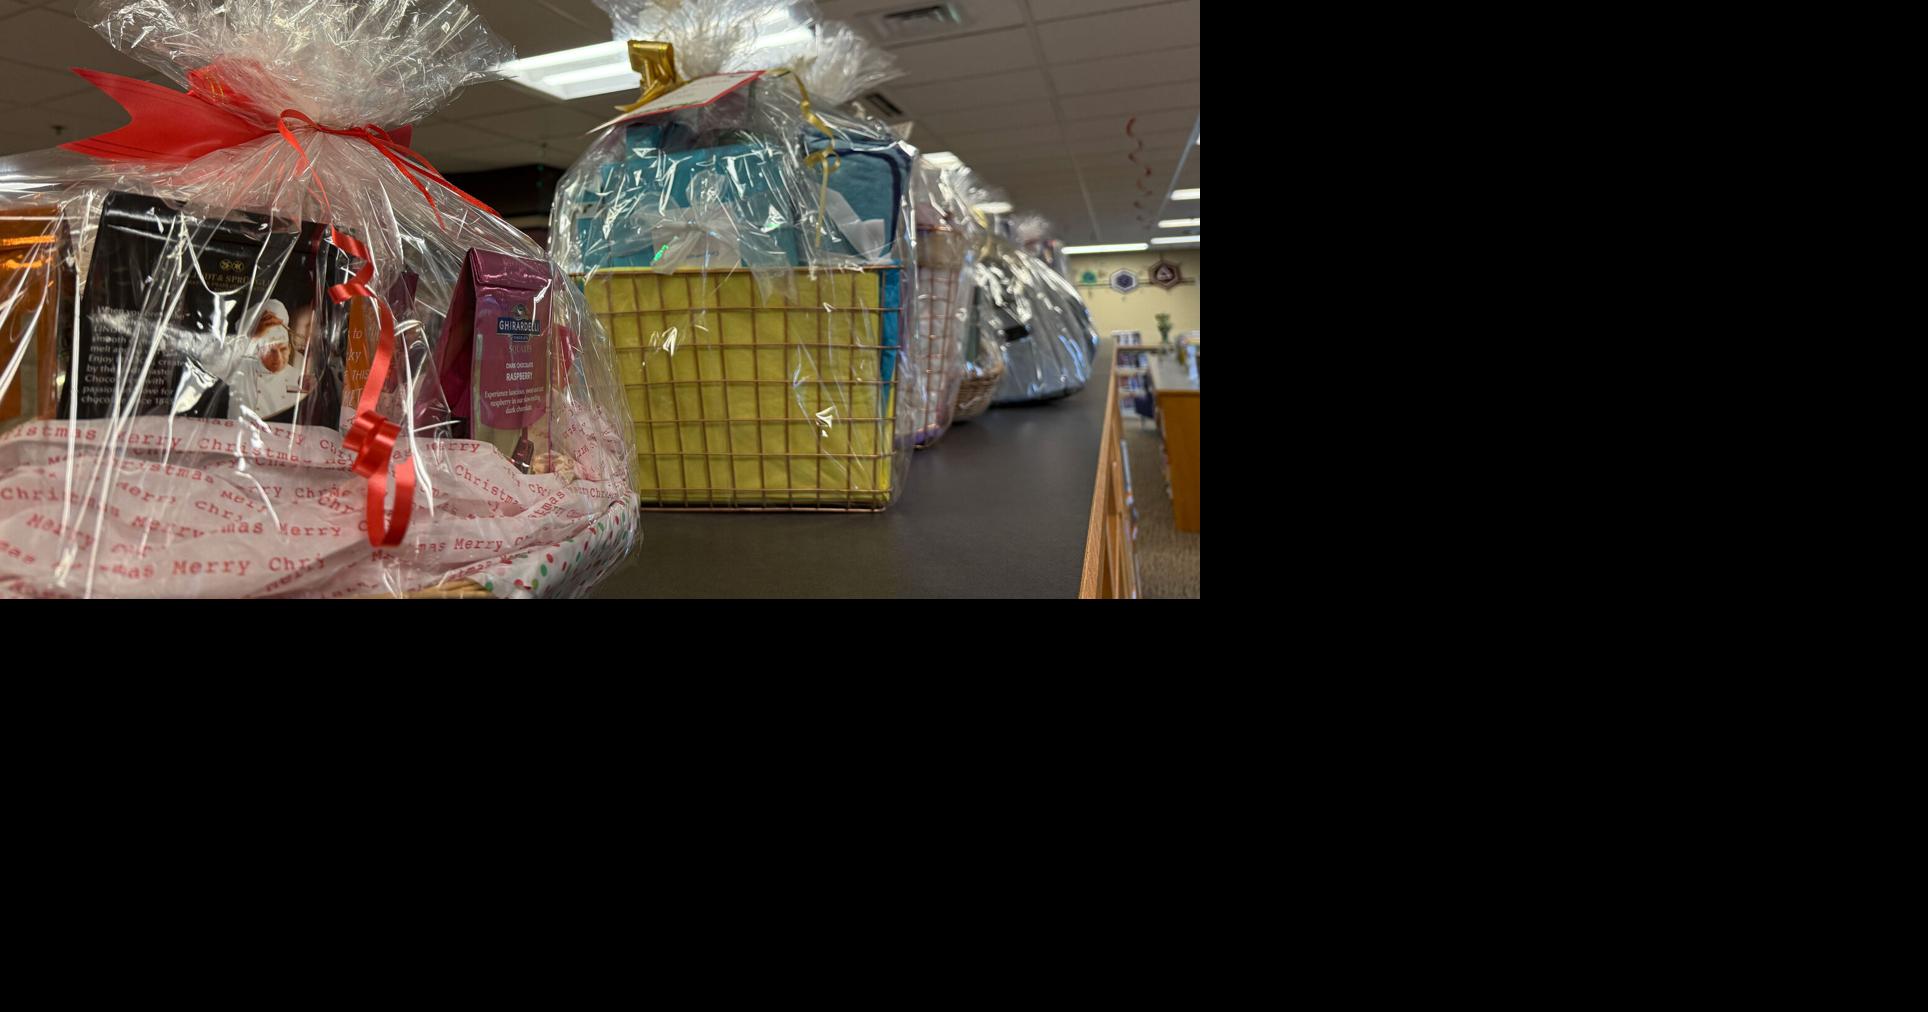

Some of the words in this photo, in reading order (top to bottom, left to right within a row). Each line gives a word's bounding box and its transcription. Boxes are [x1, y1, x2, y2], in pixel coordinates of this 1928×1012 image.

[499, 320, 540, 332] GHIRARDELLI
[352, 328, 362, 339] to
[90, 345, 111, 353] melt
[88, 354, 113, 365] Enjoy
[87, 364, 99, 375] by
[100, 366, 116, 374] the
[352, 369, 371, 380] THIS
[506, 371, 533, 381] RASPBERRY
[453, 537, 503, 553] Merry
[173, 560, 250, 576] Merry
